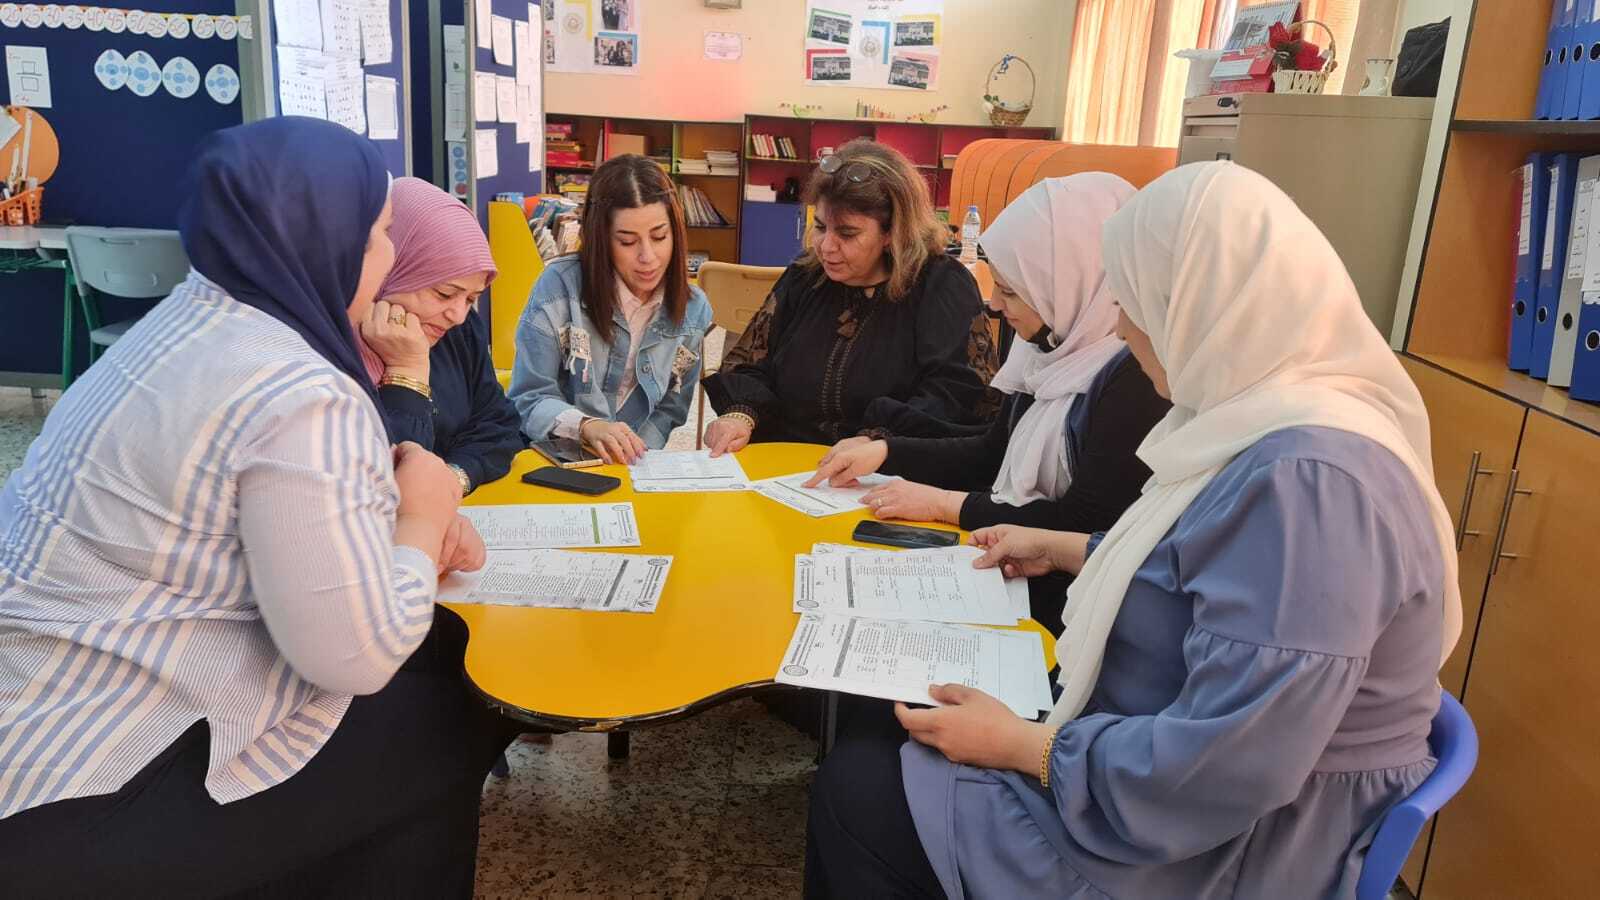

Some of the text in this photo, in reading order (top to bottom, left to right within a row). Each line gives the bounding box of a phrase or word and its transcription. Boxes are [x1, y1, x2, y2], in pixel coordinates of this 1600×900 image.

[24, 9, 40, 23] 25
[86, 11, 103, 26] 40
[107, 14, 124, 29] 45
[217, 18, 234, 35] 70
